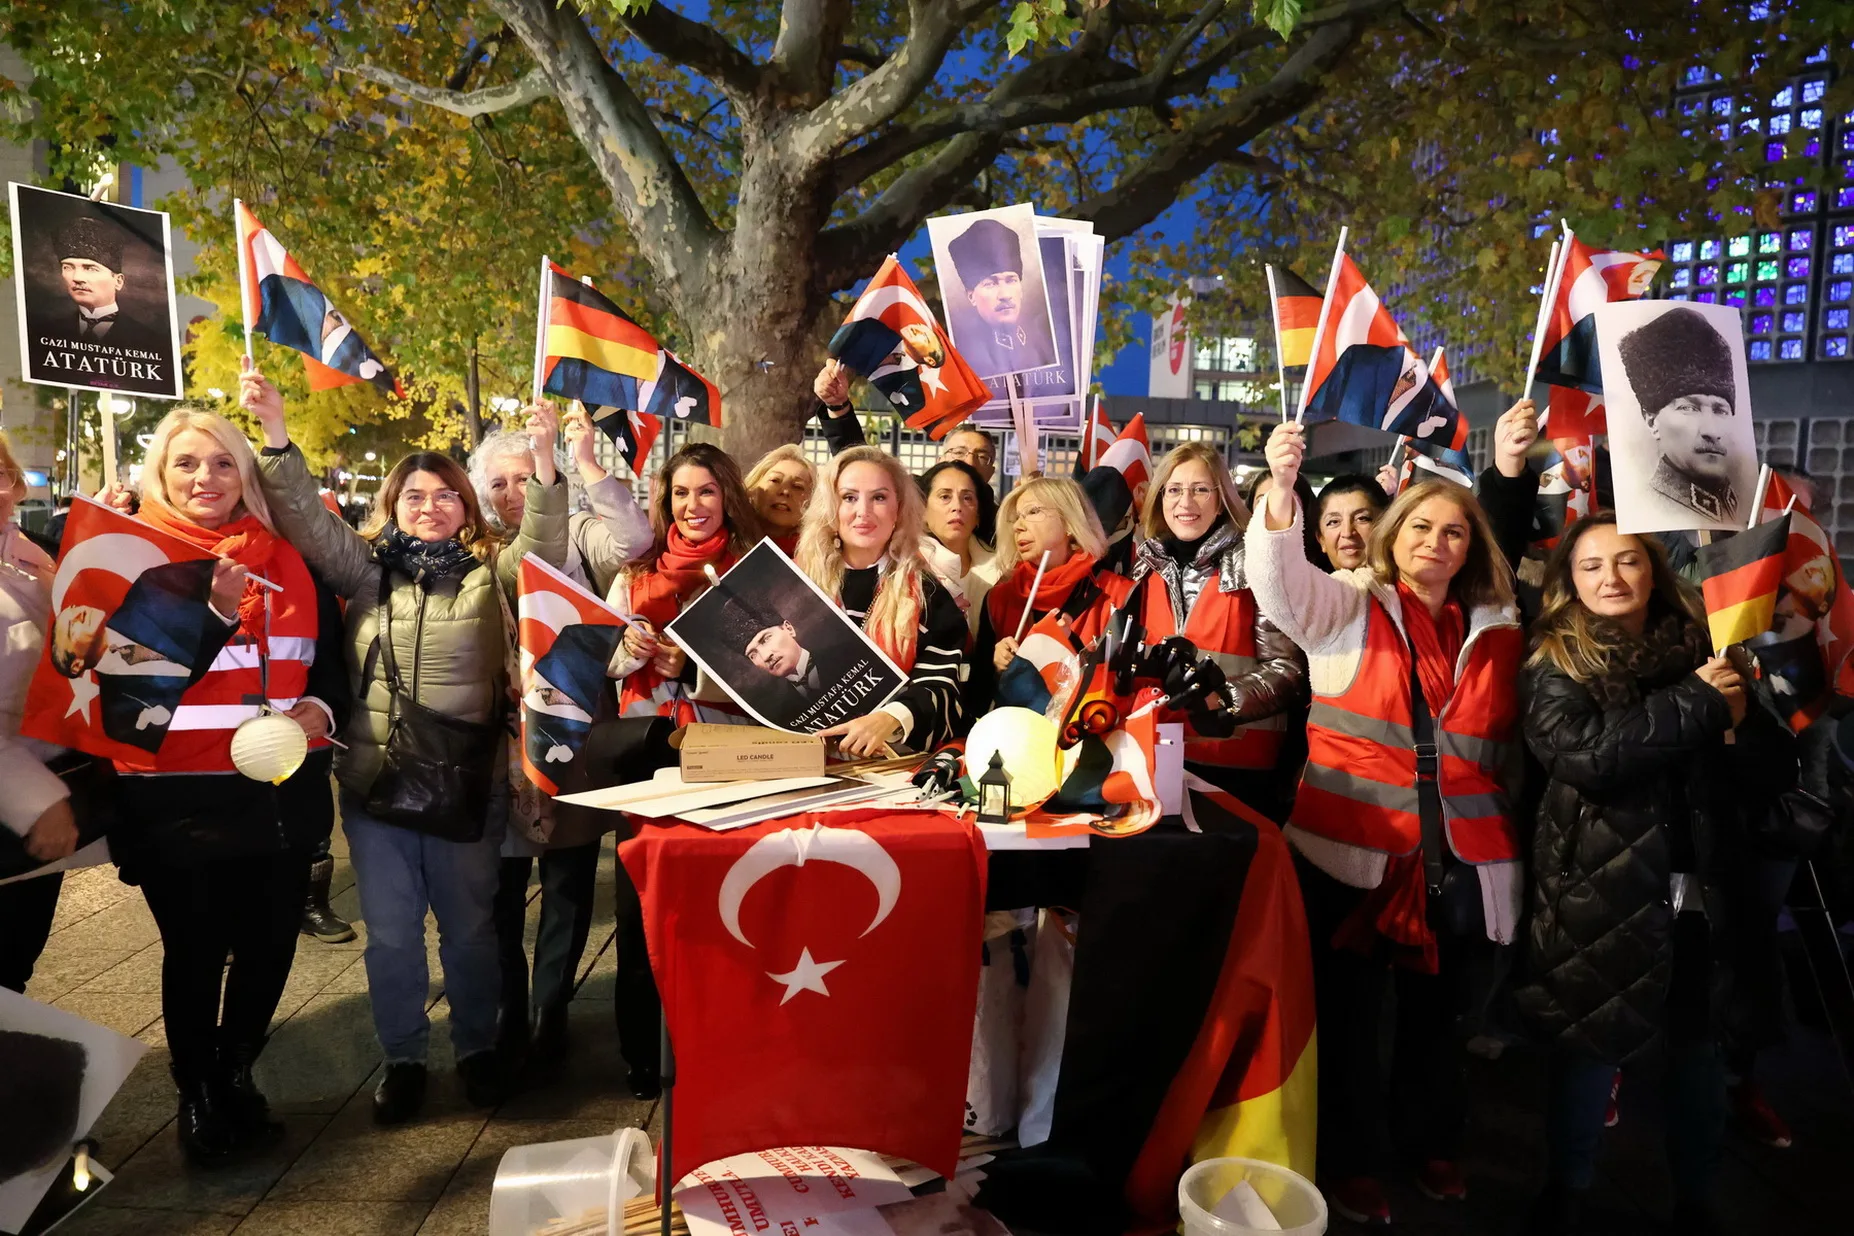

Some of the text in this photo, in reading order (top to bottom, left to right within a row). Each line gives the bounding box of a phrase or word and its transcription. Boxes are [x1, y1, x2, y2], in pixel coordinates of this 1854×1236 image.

[43, 350, 163, 381] ATATÜRK
[70, 341, 122, 356] MUSTAFA
[125, 348, 162, 361] KEMAL
[804, 667, 884, 733] ATATÜRK
[807, 683, 843, 716] MUSTAFA
[841, 659, 869, 685] KEMAL
